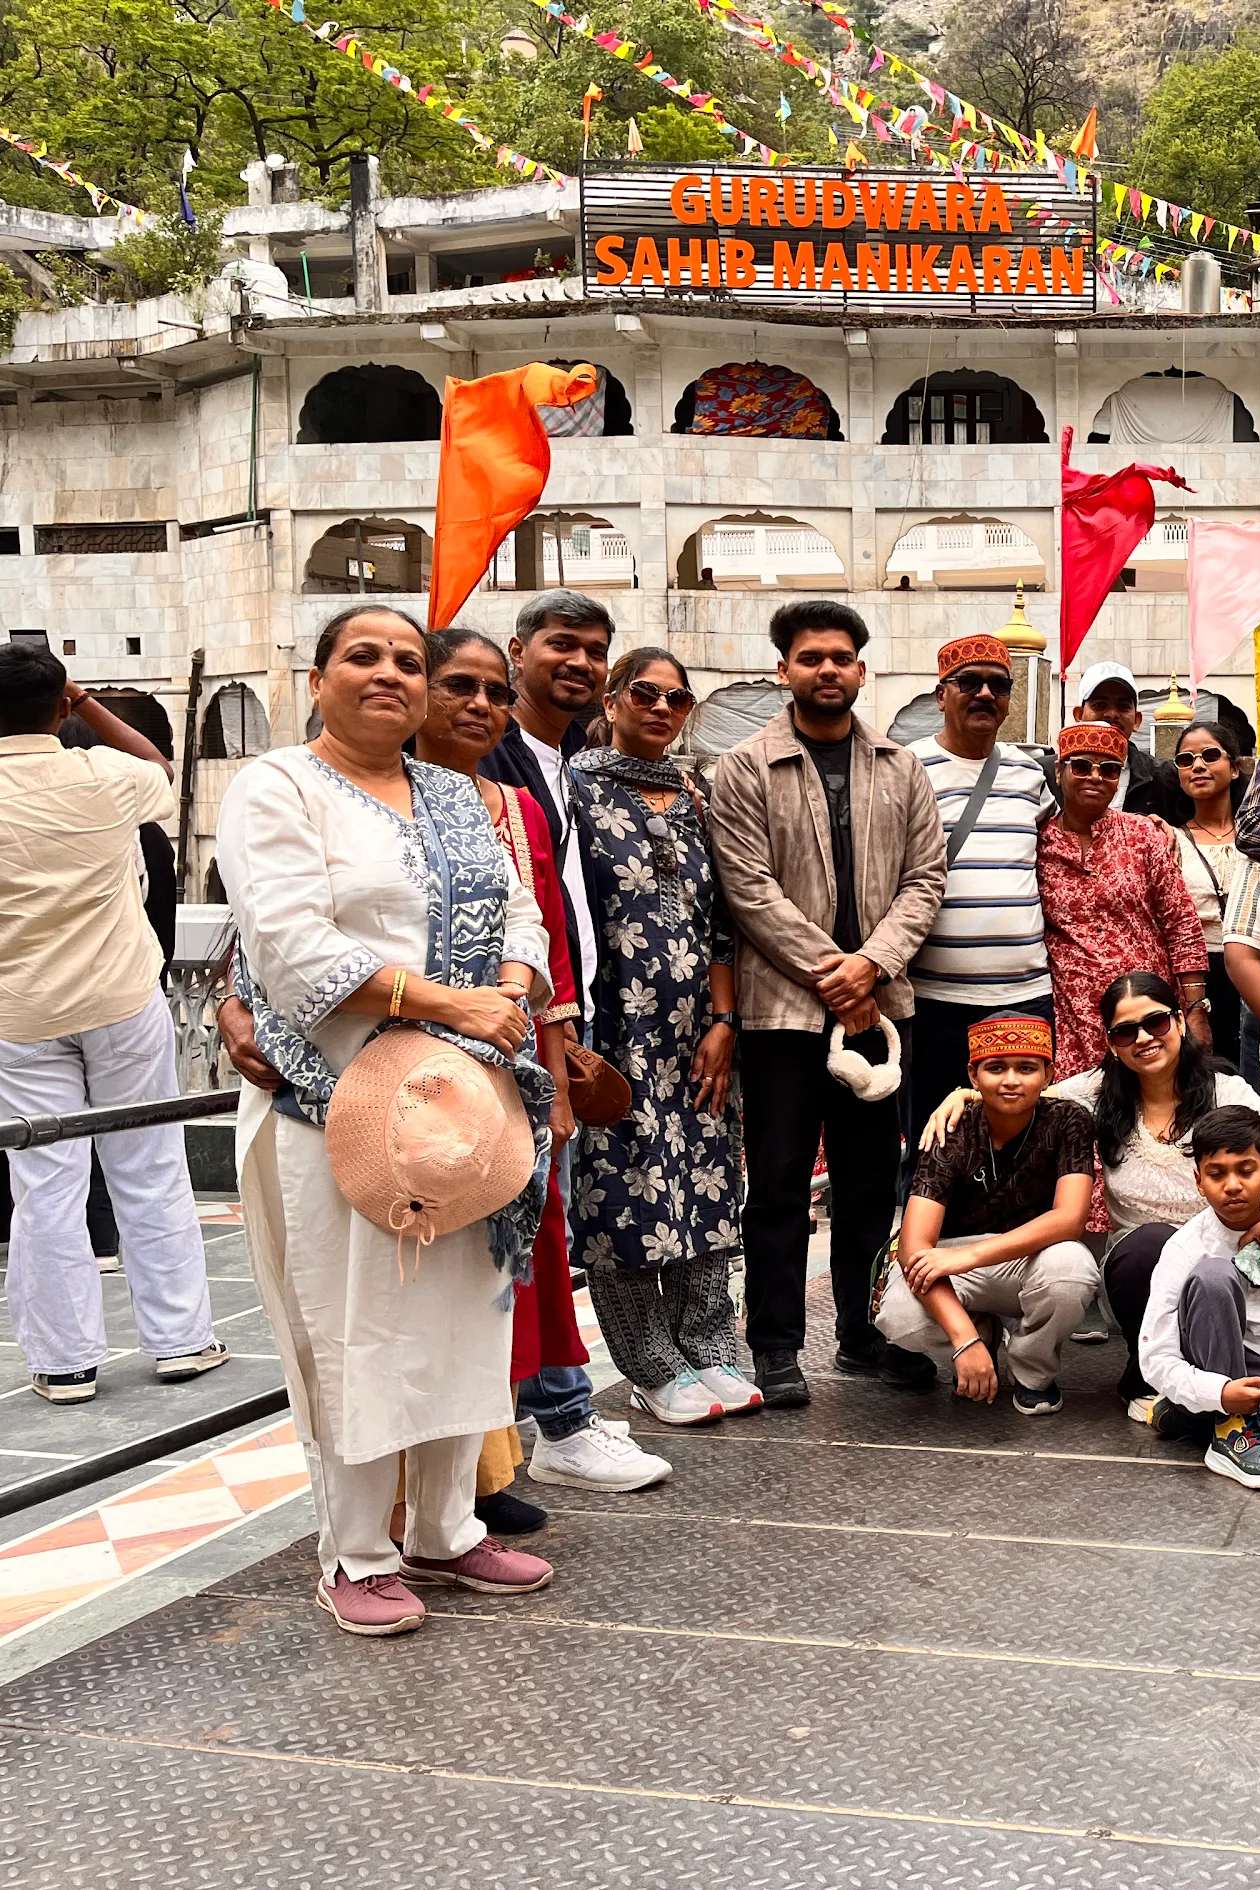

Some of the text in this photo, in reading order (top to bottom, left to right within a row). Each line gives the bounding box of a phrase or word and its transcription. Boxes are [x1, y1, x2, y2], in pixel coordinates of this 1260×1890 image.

[670, 175, 1012, 233] GURUDWARA
[594, 235, 1085, 295] SAHIB MANIKARAN
